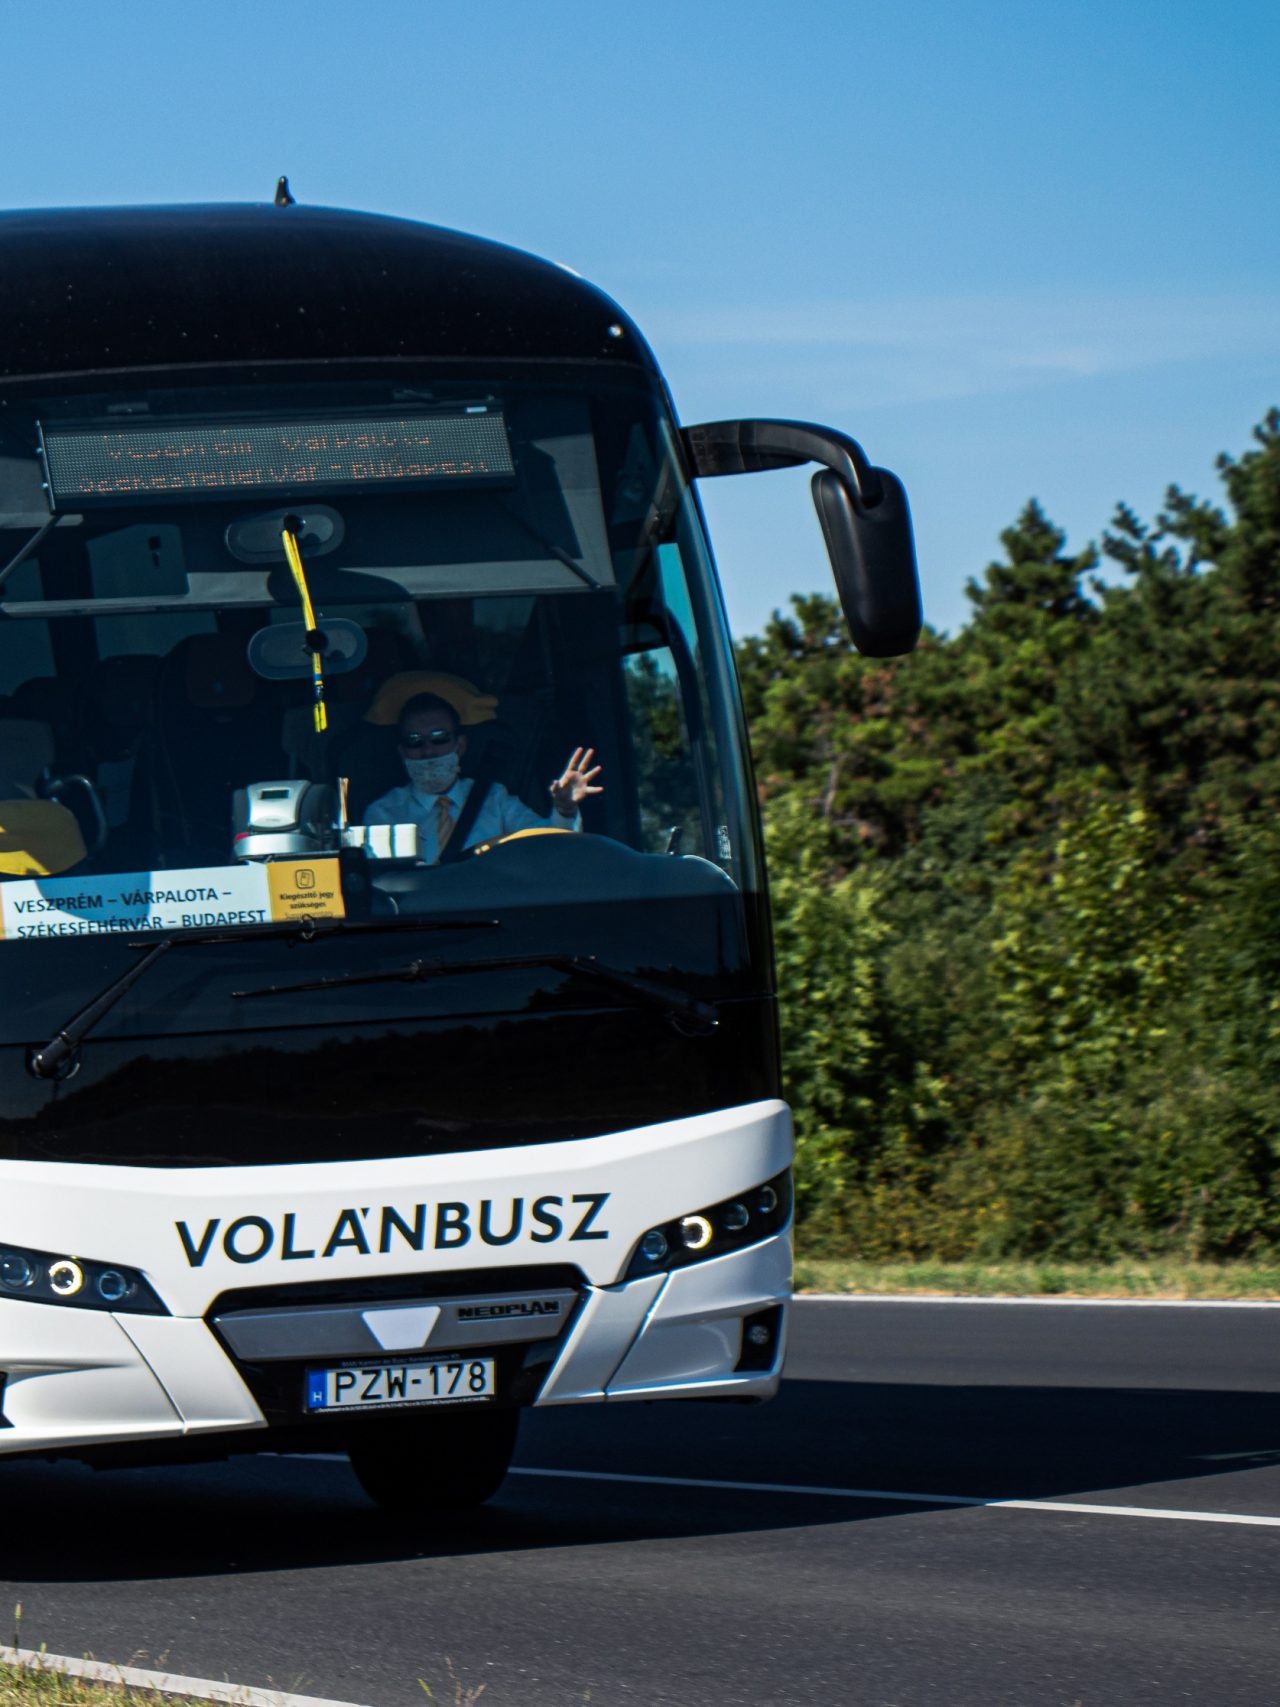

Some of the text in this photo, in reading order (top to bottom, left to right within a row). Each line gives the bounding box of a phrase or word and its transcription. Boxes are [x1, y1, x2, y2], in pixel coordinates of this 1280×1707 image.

[14, 892, 104, 913] VESZPRÉM
[121, 888, 218, 906] VÁRPALOTA
[17, 915, 162, 938] SZÉKESFEHÉRVÁR
[182, 909, 266, 928] BUDAPEST
[175, 1192, 611, 1268] VOLÁNBUSZ
[457, 1301, 560, 1319] NEOPLAN
[335, 1361, 486, 1403] PZW-178
[313, 1391, 322, 1402] H
